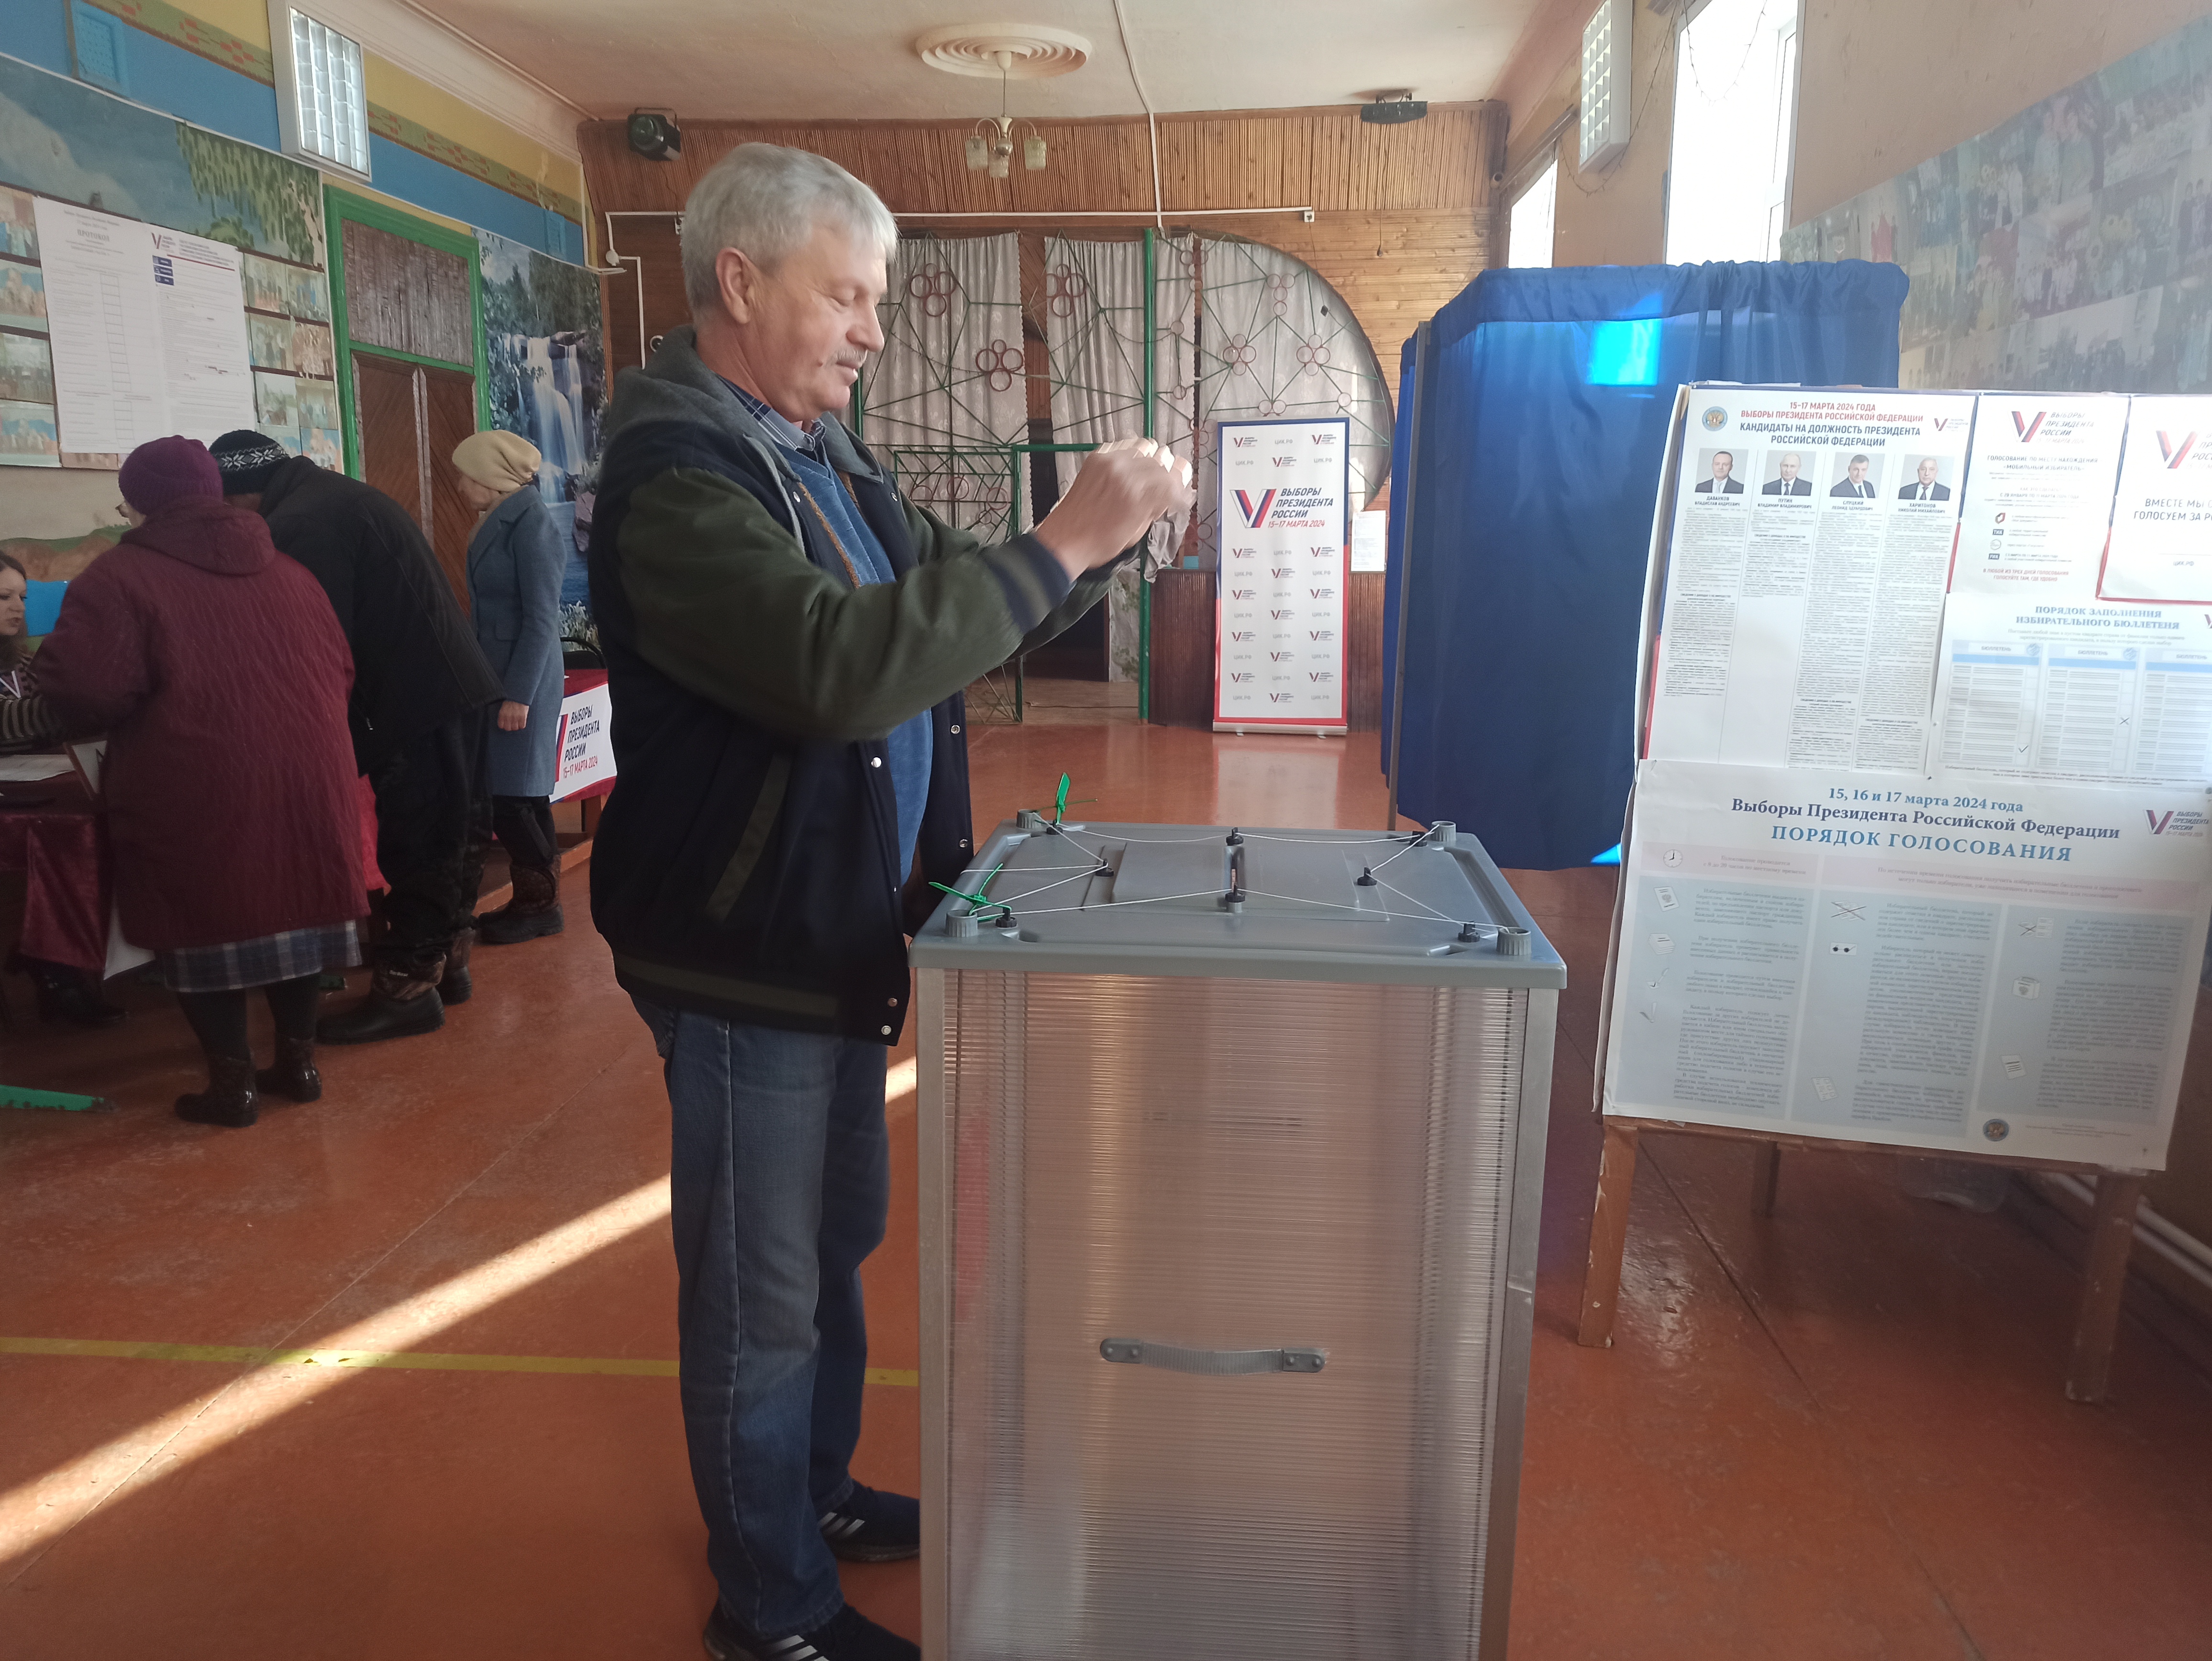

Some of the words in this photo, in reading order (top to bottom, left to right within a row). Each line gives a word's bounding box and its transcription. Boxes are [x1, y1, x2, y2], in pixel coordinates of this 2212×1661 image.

[1856, 404, 1875, 412] ГОДА
[1776, 411, 1823, 420] ПРЕЗИДЕНТА
[1825, 411, 1875, 421] РОССИЙСКОЙ
[1877, 414, 1923, 423] ФЕДЕРАЦИИ
[1740, 422, 1793, 432] КАНДИДАТЫ
[1795, 424, 1806, 432] НА
[1808, 425, 1862, 433] ДОЛЖНОСТЬ
[1865, 426, 1920, 436] ПРЕЗИДЕНТА
[1771, 434, 1829, 444] РОССИЙСКОЙ
[1831, 436, 1885, 447] ФЕДЕРАЦИИ
[1280, 487, 1322, 497] ВЫБОРЫ
[1276, 498, 1334, 508] ПРЕЗИДЕНТА
[2145, 498, 2183, 507] ВМЕСТЕ
[2187, 499, 2204, 508] МЫ
[1271, 510, 1308, 519] РОССИИ
[2134, 511, 2186, 520] ГОЛОСУЕМ
[2189, 512, 2201, 520] ЗА
[1286, 520, 1308, 528] МАРТА
[2035, 606, 2087, 615] ПОРЯДОК
[2089, 608, 2162, 618] ЗАПОЛНЕНИЯ
[2016, 616, 2111, 627] ИЗБИРАТЕЛЬНОГО
[2114, 620, 2179, 630] БЮЛЛЕТЕНЯ
[570, 705, 593, 724] ВЫБОРЫ
[567, 720, 600, 743] ПРЕЗИДЕНТА
[564, 742, 586, 763] РОССИИ
[574, 759, 587, 774] МАРТА
[588, 755, 598, 768] 2024
[1829, 788, 1847, 801] 15,
[1853, 789, 1869, 800] 16
[1886, 791, 1902, 802] 17
[1904, 795, 1948, 808] марта
[1953, 796, 1987, 809] 2024
[1991, 802, 2023, 812] года
[1731, 797, 1802, 818] Выборы
[1807, 804, 1907, 823] Президента
[1913, 810, 2016, 831] Российской
[2021, 818, 2120, 840] Федерации
[1771, 826, 1880, 847] ПОРЯДОК
[1888, 833, 2072, 861] ГОЛОСОВАНИЯ
